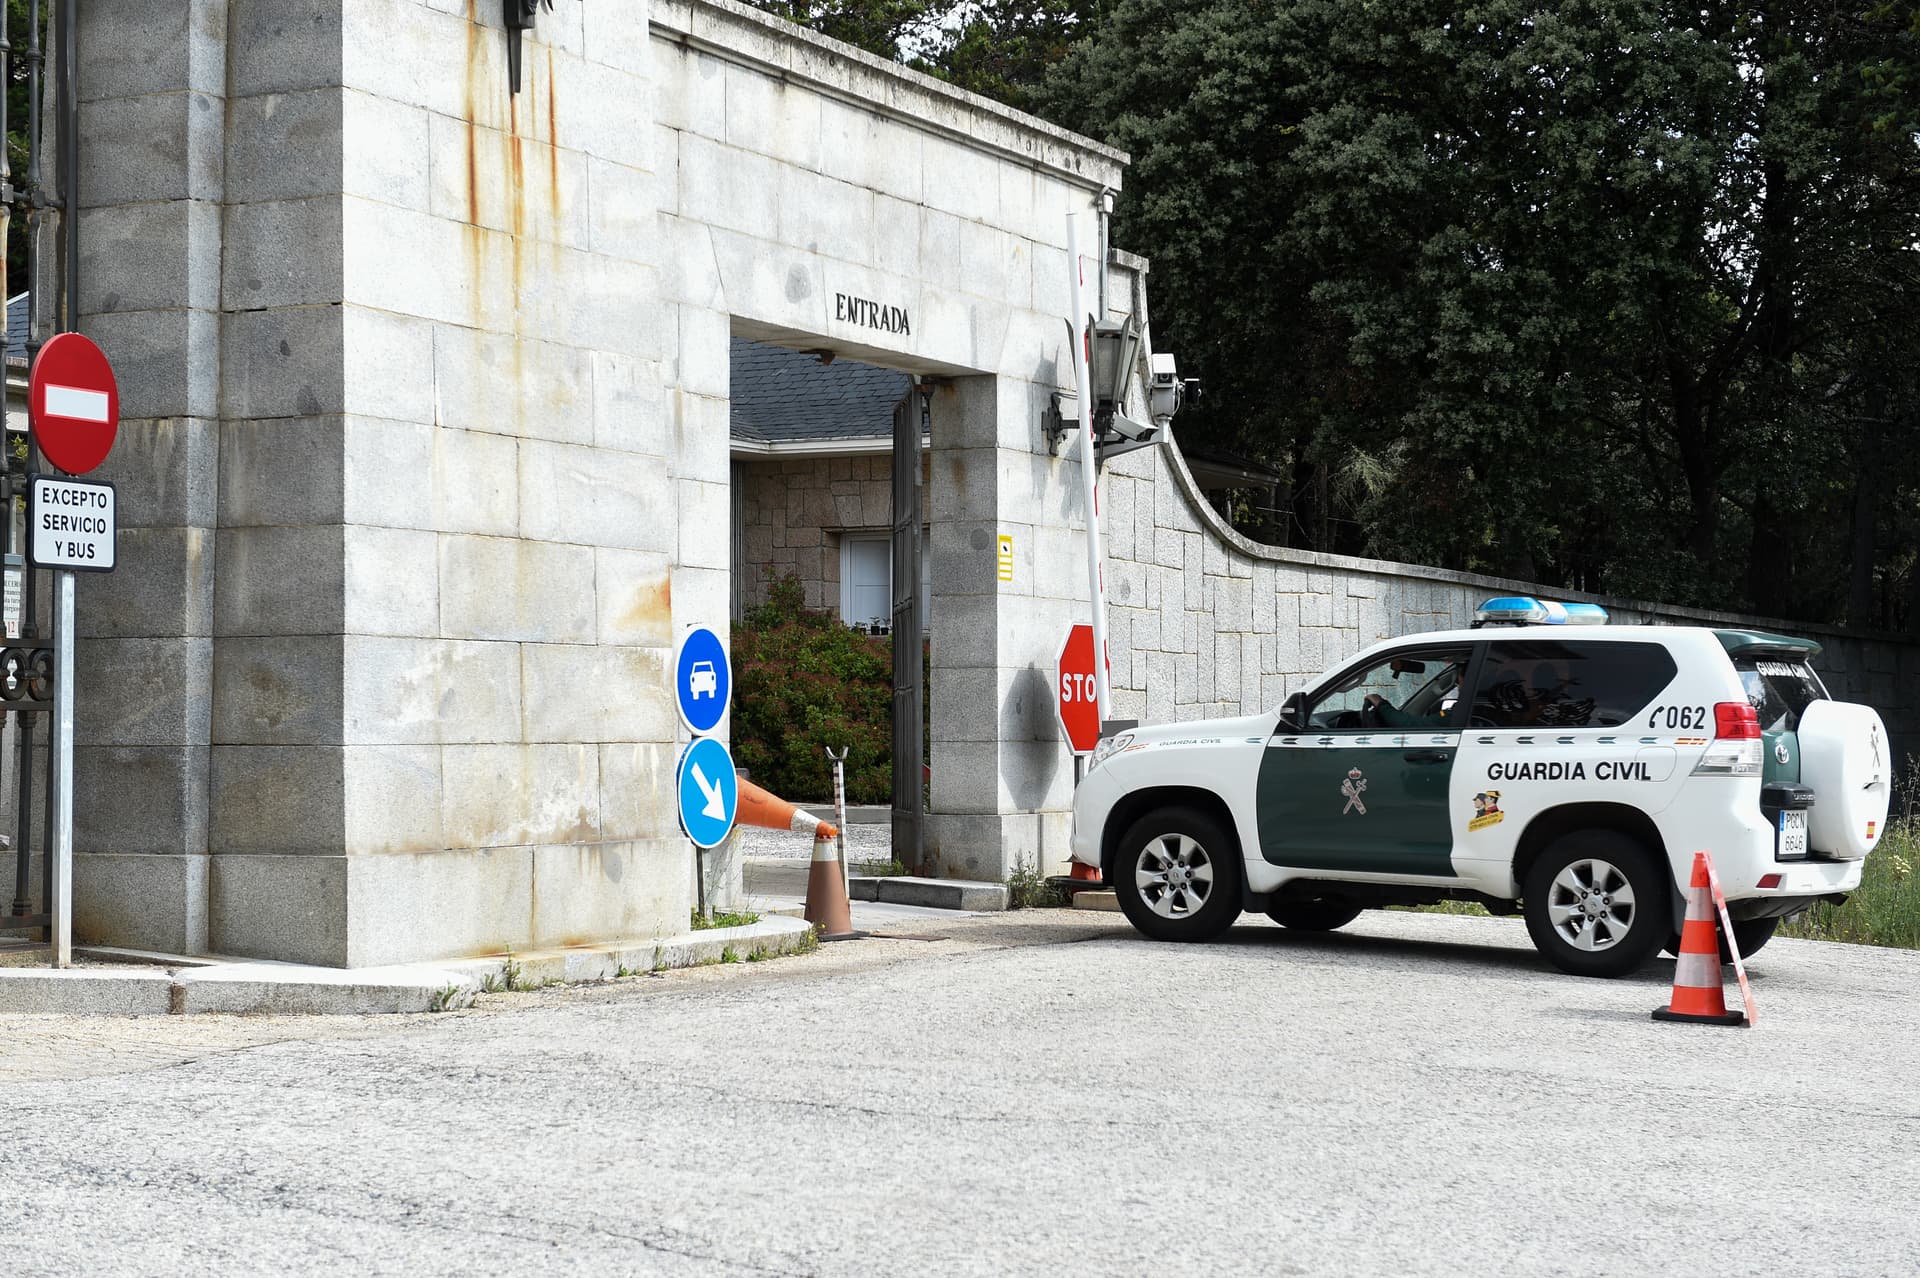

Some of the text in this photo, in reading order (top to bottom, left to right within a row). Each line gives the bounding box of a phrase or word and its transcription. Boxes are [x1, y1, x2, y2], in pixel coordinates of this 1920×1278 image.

[835, 292, 911, 336] ENTRADA
[42, 487, 107, 509] EXCEPTO
[42, 513, 106, 534] SERVICIO
[55, 540, 95, 560] Y BUS
[1062, 672, 1098, 703] STO
[1666, 705, 1706, 730] 062
[1487, 761, 1652, 781] GUARDIA CIVIL
[1785, 835, 1804, 851] 6646
